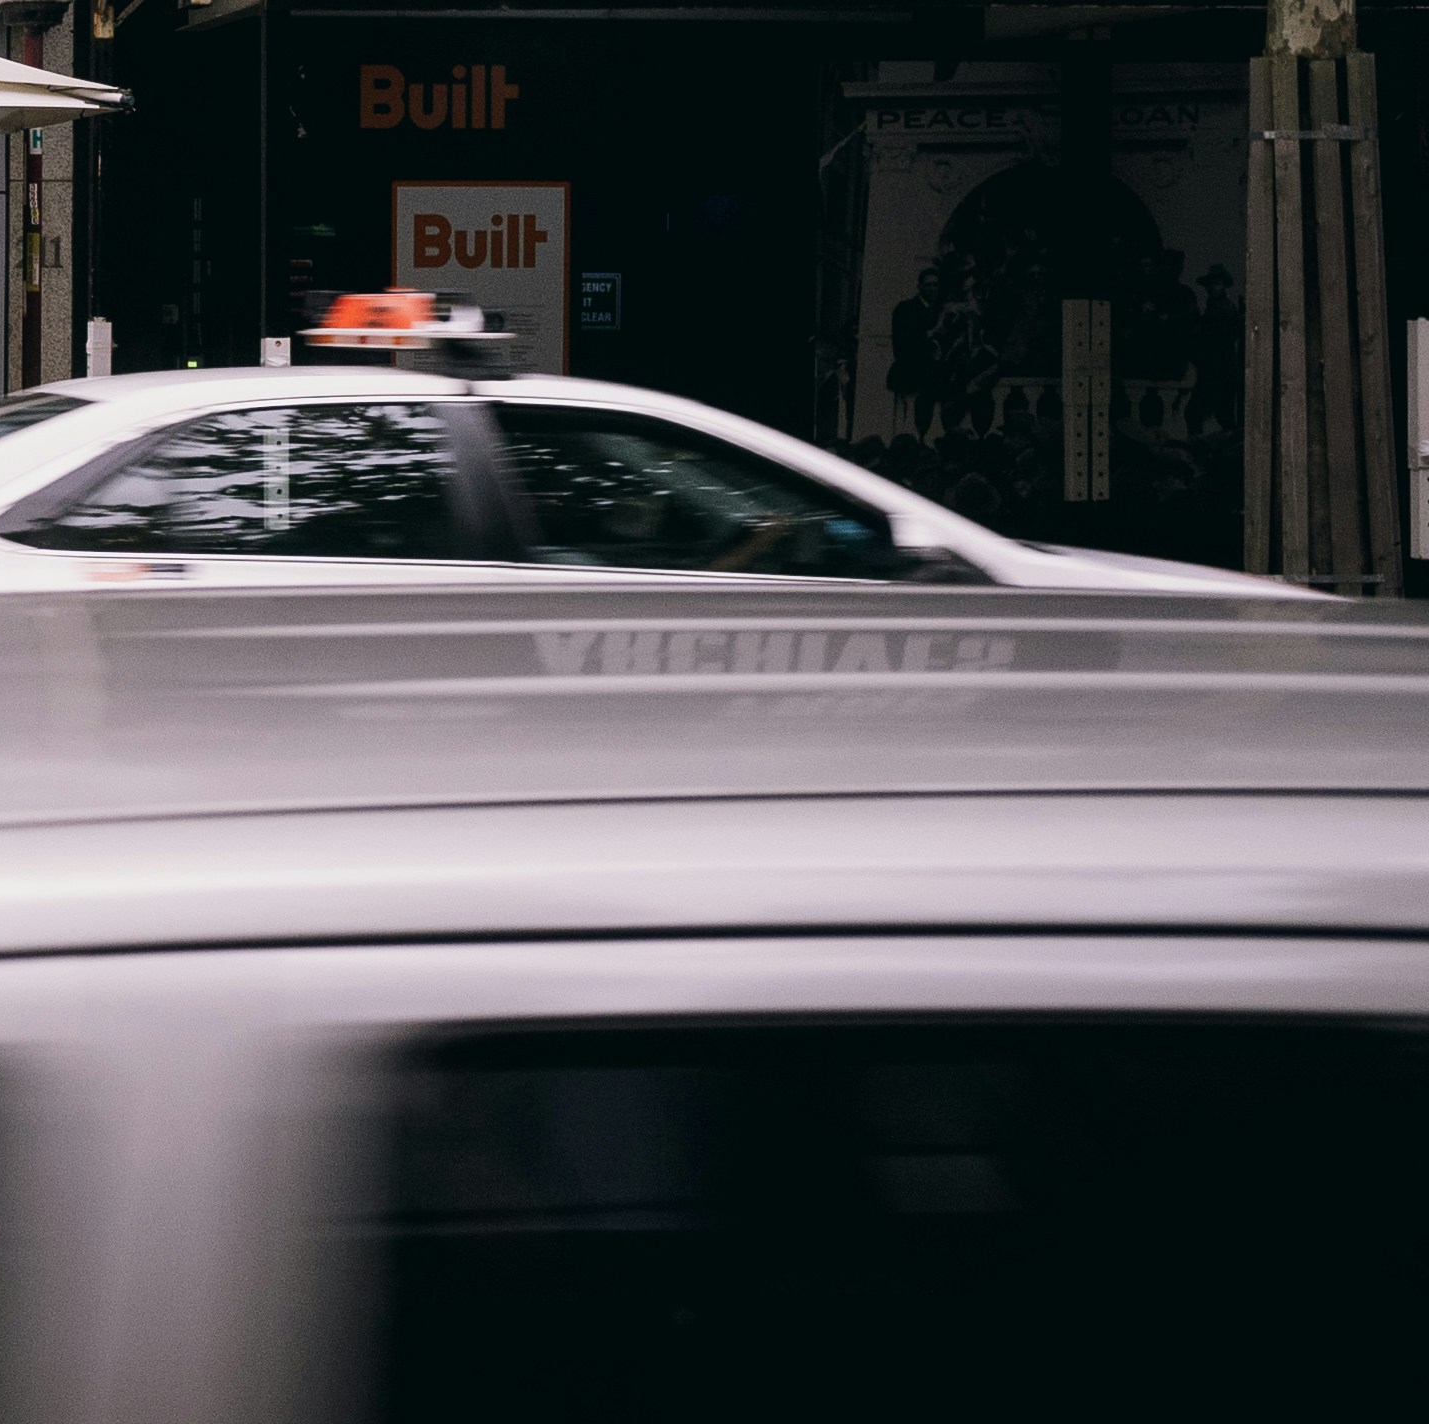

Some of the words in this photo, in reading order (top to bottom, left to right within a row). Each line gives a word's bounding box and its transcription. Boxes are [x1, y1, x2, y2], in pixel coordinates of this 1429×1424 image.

[359, 64, 520, 130] Built
[876, 109, 1007, 130] PEACE
[413, 213, 548, 269] Built
